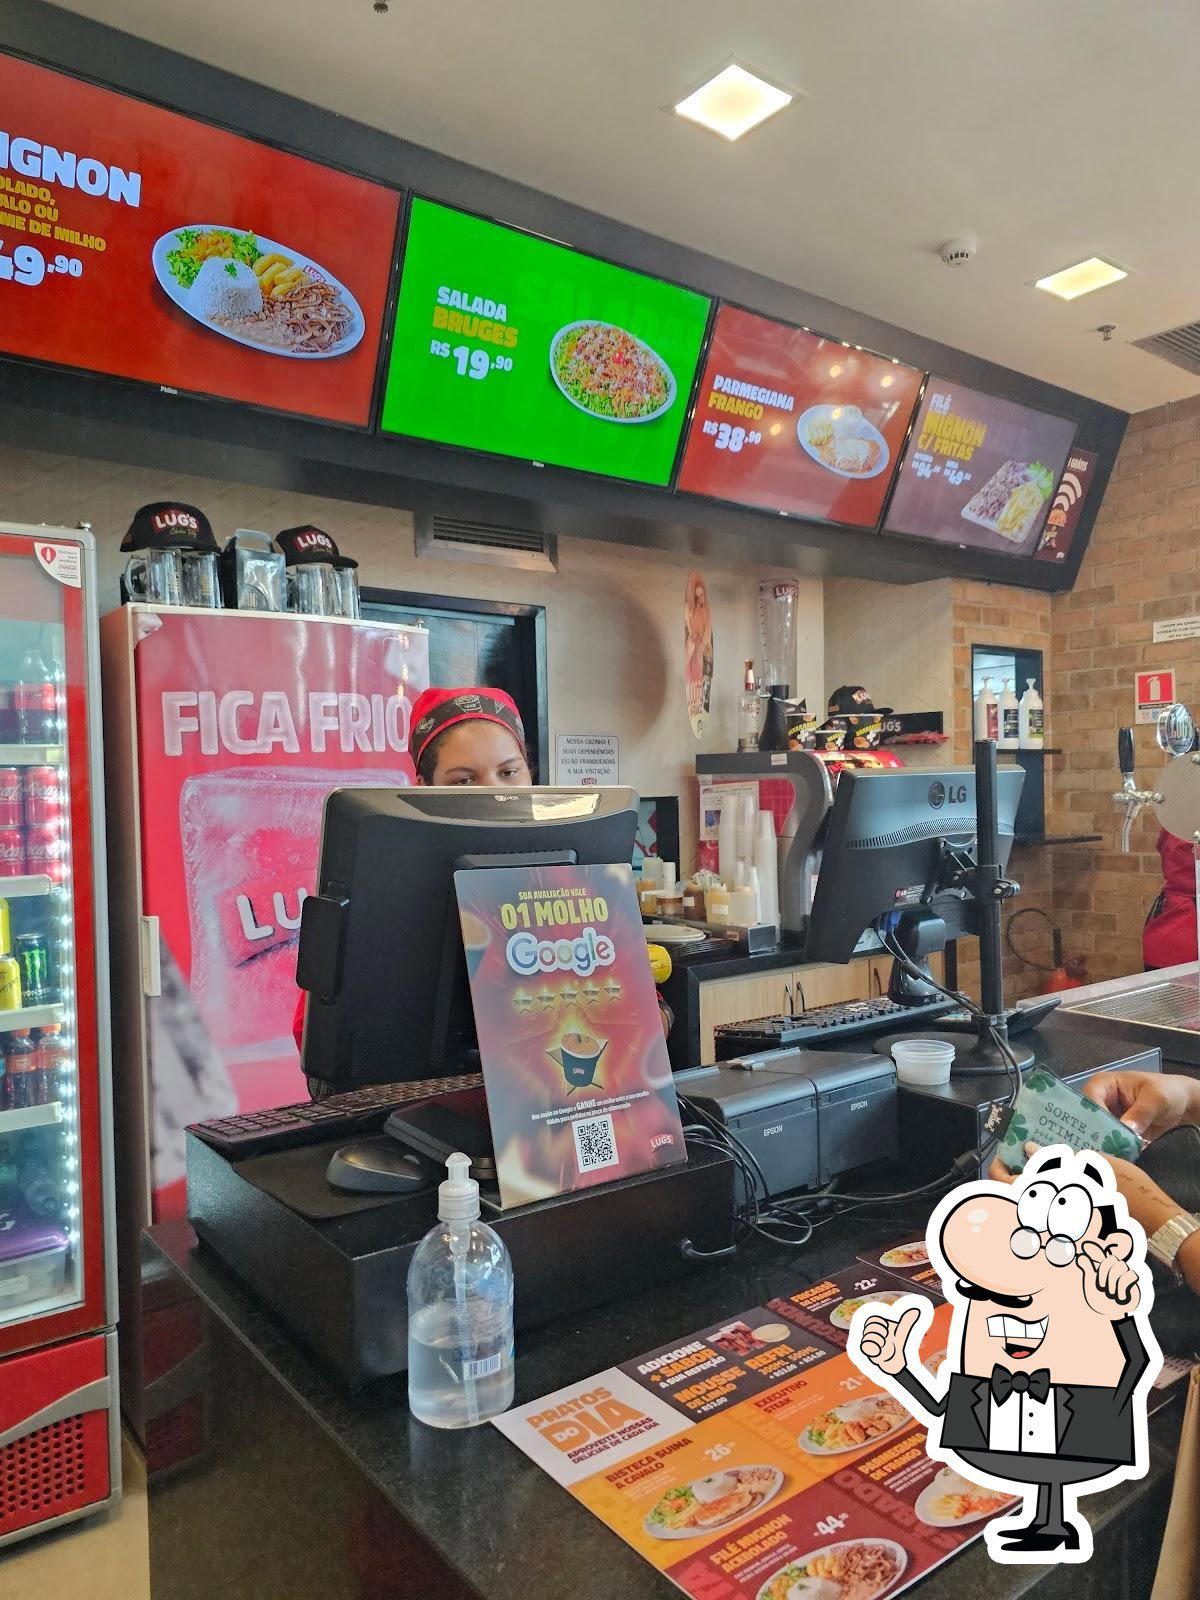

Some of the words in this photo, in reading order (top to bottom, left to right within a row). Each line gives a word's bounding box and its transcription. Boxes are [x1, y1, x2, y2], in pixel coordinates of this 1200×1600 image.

[34, 203, 59, 222] OU
[29, 218, 52, 238] DE
[54, 225, 107, 252] MILHO
[437, 286, 507, 322] SALADA
[432, 305, 519, 348] BRUGES
[430, 340, 451, 358] R$
[708, 391, 764, 421] FRANGO
[713, 374, 795, 412] PARMEGIANA
[922, 411, 988, 448] MIGNON
[932, 437, 975, 462] FRITAS
[161, 691, 300, 757] FICA
[308, 691, 413, 753] FRIO
[948, 785, 967, 804] LG
[518, 890, 533, 901] SUA
[533, 888, 570, 900] AVALIAÇÃO
[570, 887, 587, 897] VALE
[501, 902, 531, 930] 01
[534, 896, 609, 928] MOLHO
[511, 932, 611, 972] Google
[576, 1099, 596, 1110] GANHE
[851, 1100, 868, 1111] EPSON
[1044, 1102, 1088, 1134] SORTE
[763, 1125, 783, 1137] EPSON
[637, 1340, 707, 1375] ADICIONE
[659, 1348, 719, 1379] SABOR
[659, 1380, 668, 1389] A
[667, 1373, 684, 1386] SUA
[682, 1355, 727, 1379] REFEIÇÃO
[744, 1343, 796, 1370] REFRI
[758, 1360, 789, 1377] 300ML
[789, 1345, 819, 1364] 500ML
[672, 1366, 747, 1404] MOUSSE
[685, 1397, 701, 1411] DE
[700, 1382, 737, 1405] LIMÃO
[754, 1379, 809, 1408] EXECUTIVO
[526, 1386, 613, 1429] PRATOS
[538, 1398, 647, 1453] DIA
[551, 1426, 580, 1443] DO
[567, 1428, 618, 1459] APROVEITE
[617, 1416, 654, 1438] NOSSAS
[611, 1437, 623, 1448] DE
[622, 1428, 646, 1443] CADA
[645, 1420, 661, 1433] DIA
[604, 1455, 655, 1483] BISTECA
[624, 1462, 666, 1486] CAVALO
[869, 1469, 887, 1481] DE
[884, 1448, 923, 1475] FRANGO
[735, 1513, 793, 1549] MIGNON
[721, 1530, 789, 1573] ACEBOLADO
